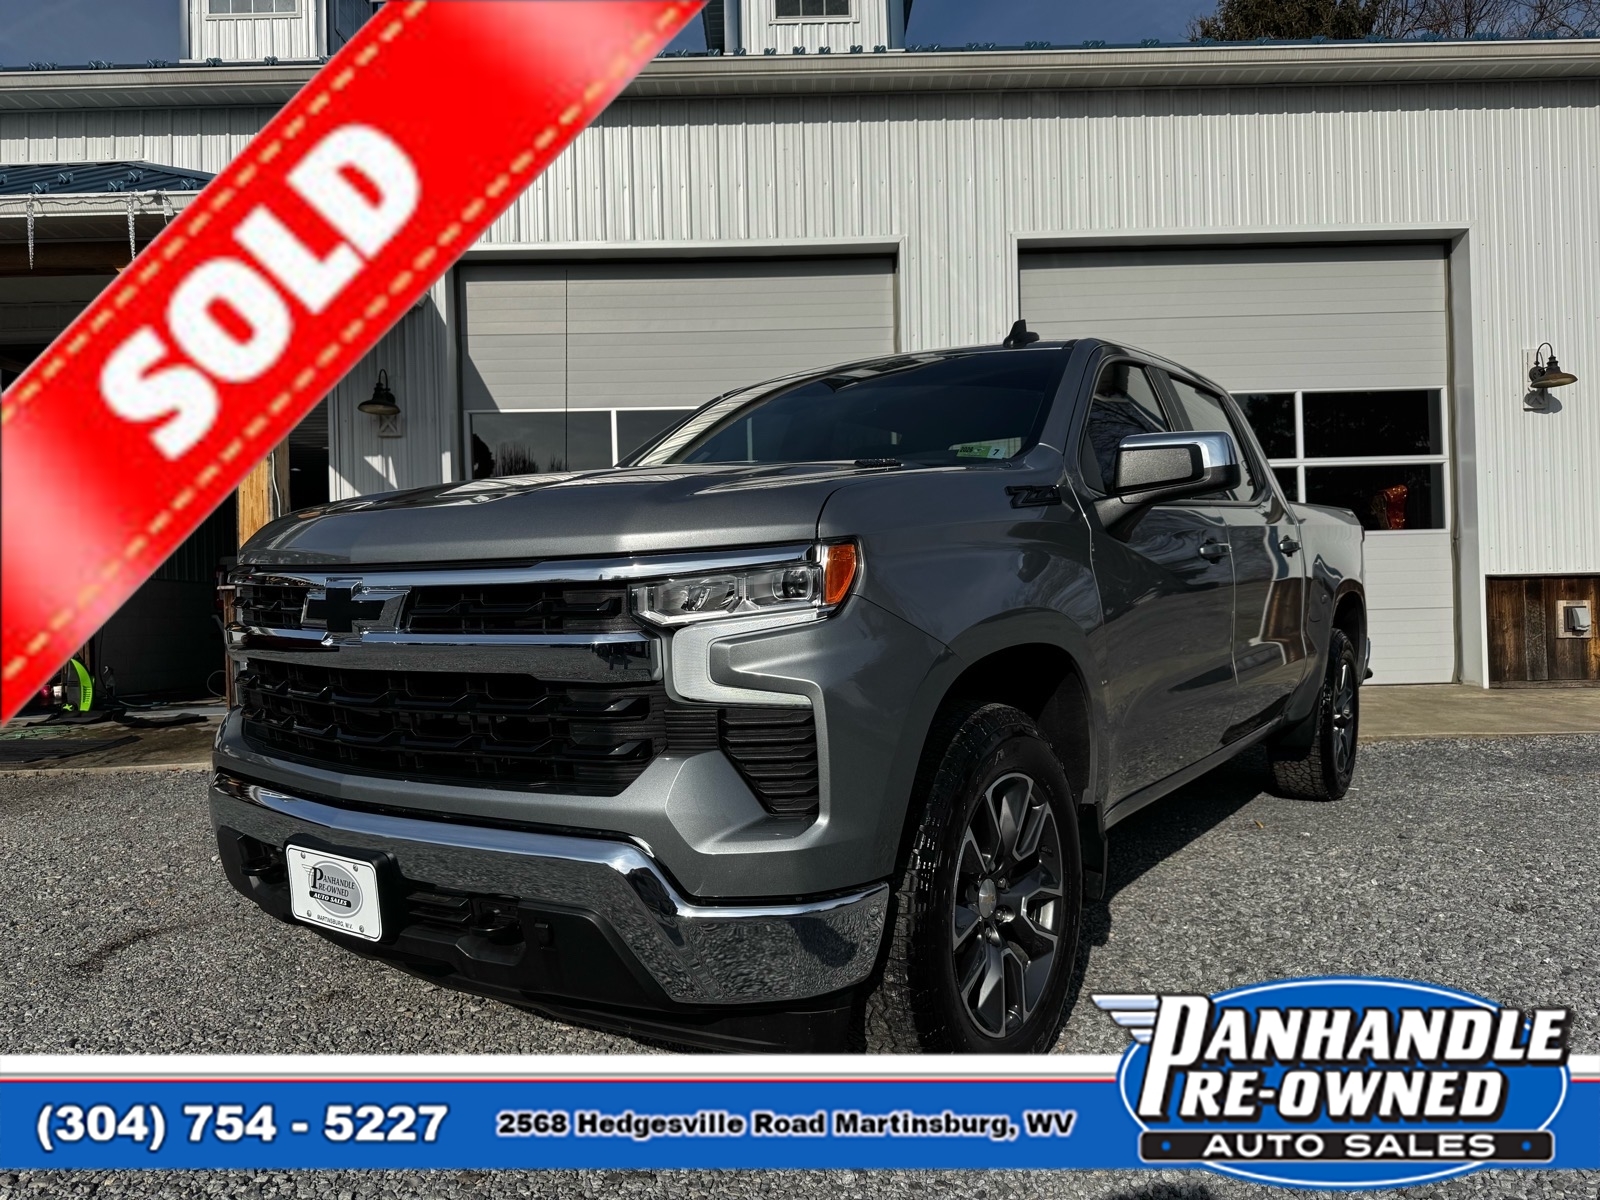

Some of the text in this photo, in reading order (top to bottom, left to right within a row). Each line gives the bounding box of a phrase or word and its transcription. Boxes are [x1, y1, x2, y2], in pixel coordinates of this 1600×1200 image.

[311, 867, 355, 890] PANHANDLE
[313, 892, 348, 906] AUTO SALES
